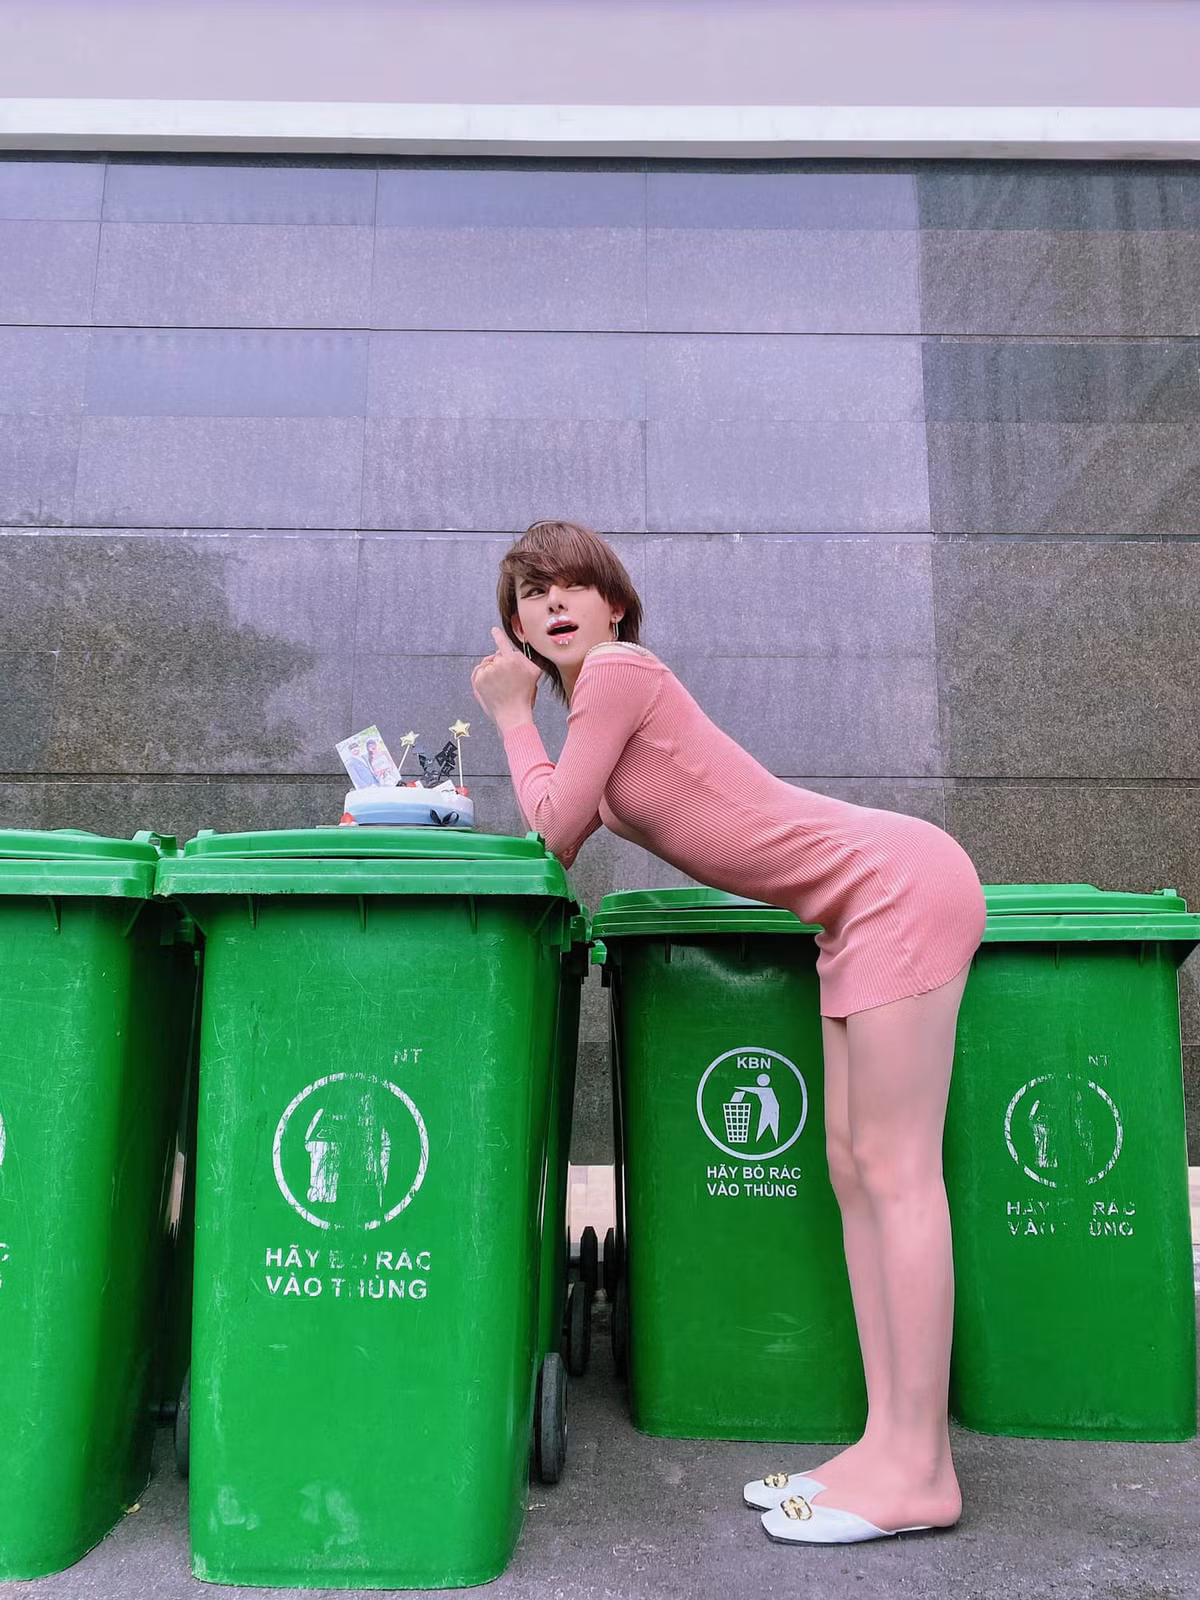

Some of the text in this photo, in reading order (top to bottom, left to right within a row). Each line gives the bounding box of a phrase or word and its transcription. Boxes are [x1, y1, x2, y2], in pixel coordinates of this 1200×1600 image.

[736, 1056, 771, 1070] KBN
[707, 1163, 738, 1179] HÃY
[769, 1164, 801, 1180] RÁC
[706, 1180, 798, 1197] VÀO THÙNG
[265, 1244, 320, 1269] HÃY
[375, 1248, 432, 1271] RÁC
[265, 1271, 323, 1297] VÀO
